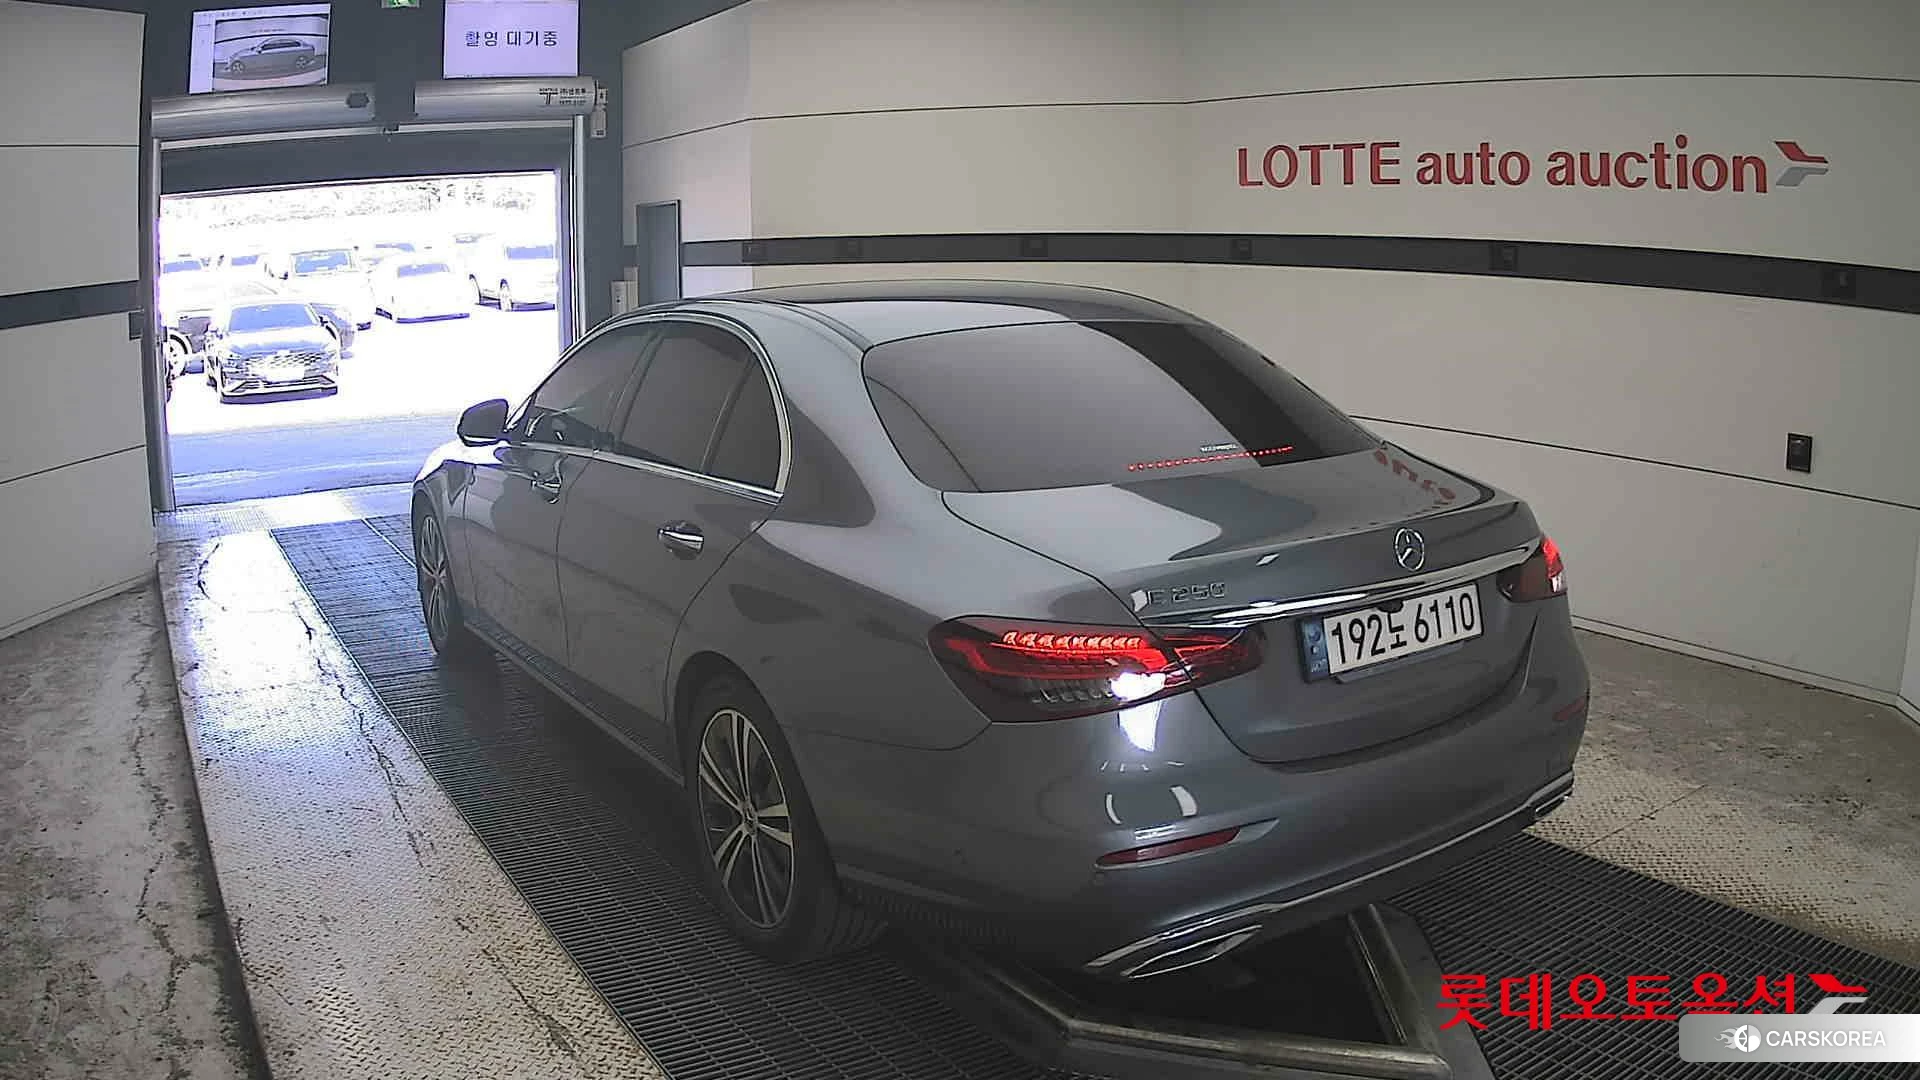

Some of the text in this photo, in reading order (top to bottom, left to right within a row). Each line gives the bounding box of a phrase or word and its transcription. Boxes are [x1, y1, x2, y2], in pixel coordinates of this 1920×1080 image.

[1238, 134, 1768, 194] LOTTE auto auction
[1171, 582, 1225, 603] 250
[1414, 592, 1475, 643] 6110
